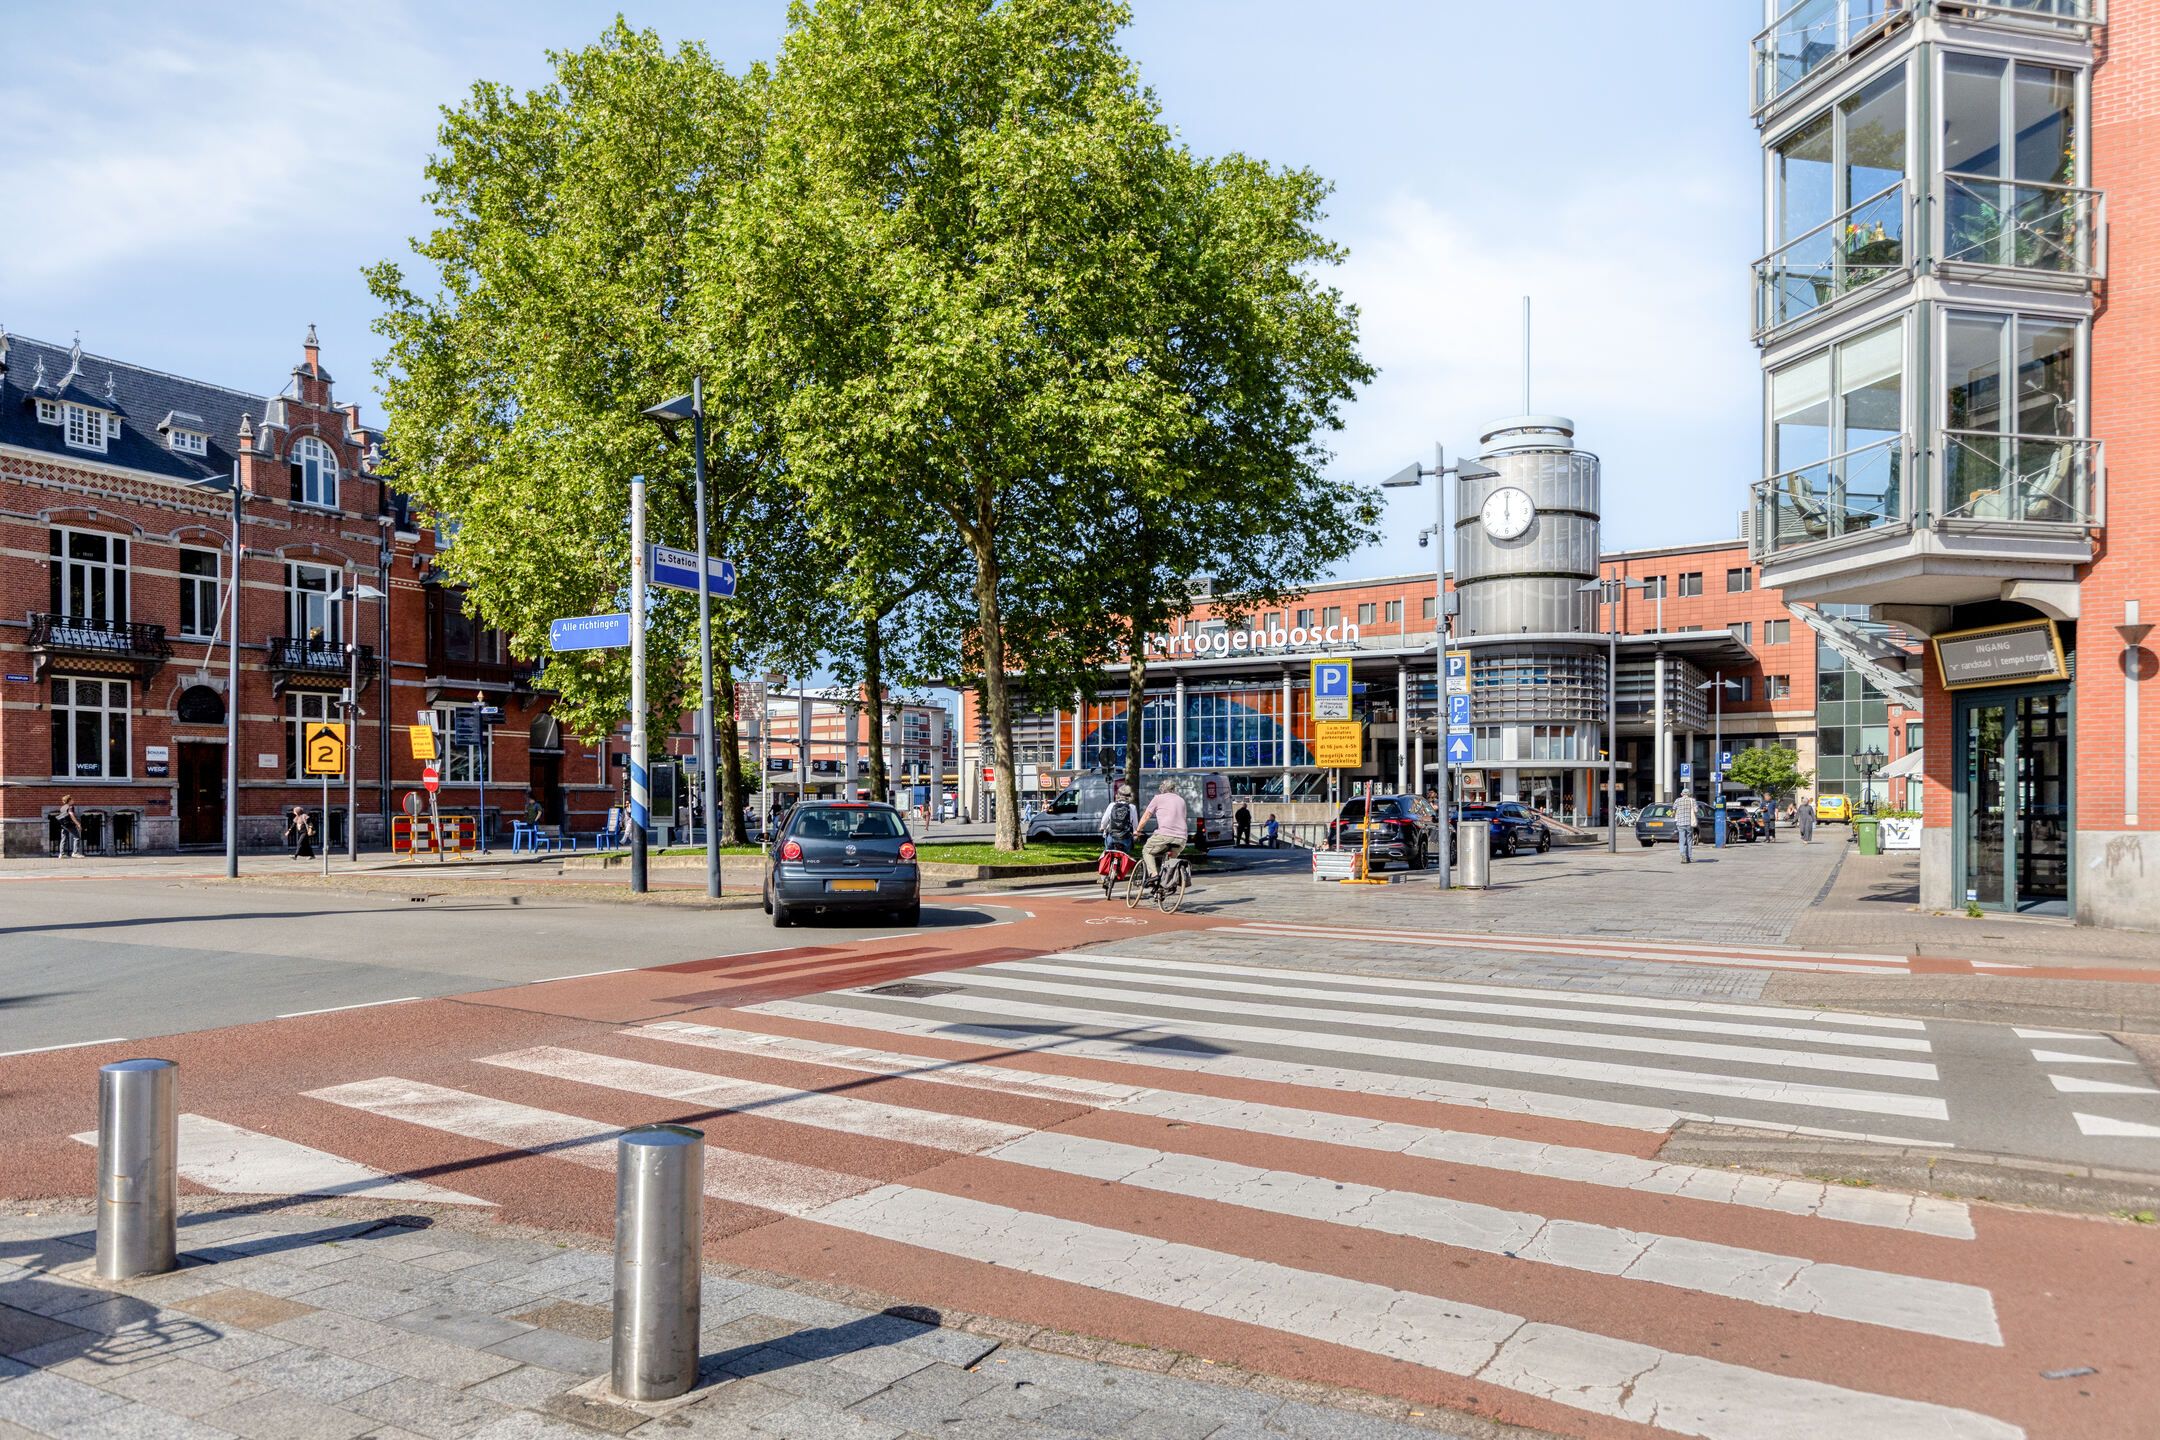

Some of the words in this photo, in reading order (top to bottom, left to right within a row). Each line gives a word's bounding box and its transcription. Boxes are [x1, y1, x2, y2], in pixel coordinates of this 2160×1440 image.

[668, 554, 697, 568] Station
[562, 622, 577, 631] Alle
[579, 619, 619, 631] richtingen
[1976, 642, 2010, 653] INGANG
[1450, 658, 1462, 676] P
[1961, 659, 1992, 670] randstad
[2000, 656, 2025, 666] tempo
[2026, 654, 2045, 662] team
[1323, 668, 1340, 694] P
[1454, 698, 1464, 712] P
[318, 746, 334, 762] 2
[1723, 752, 1730, 762] P
